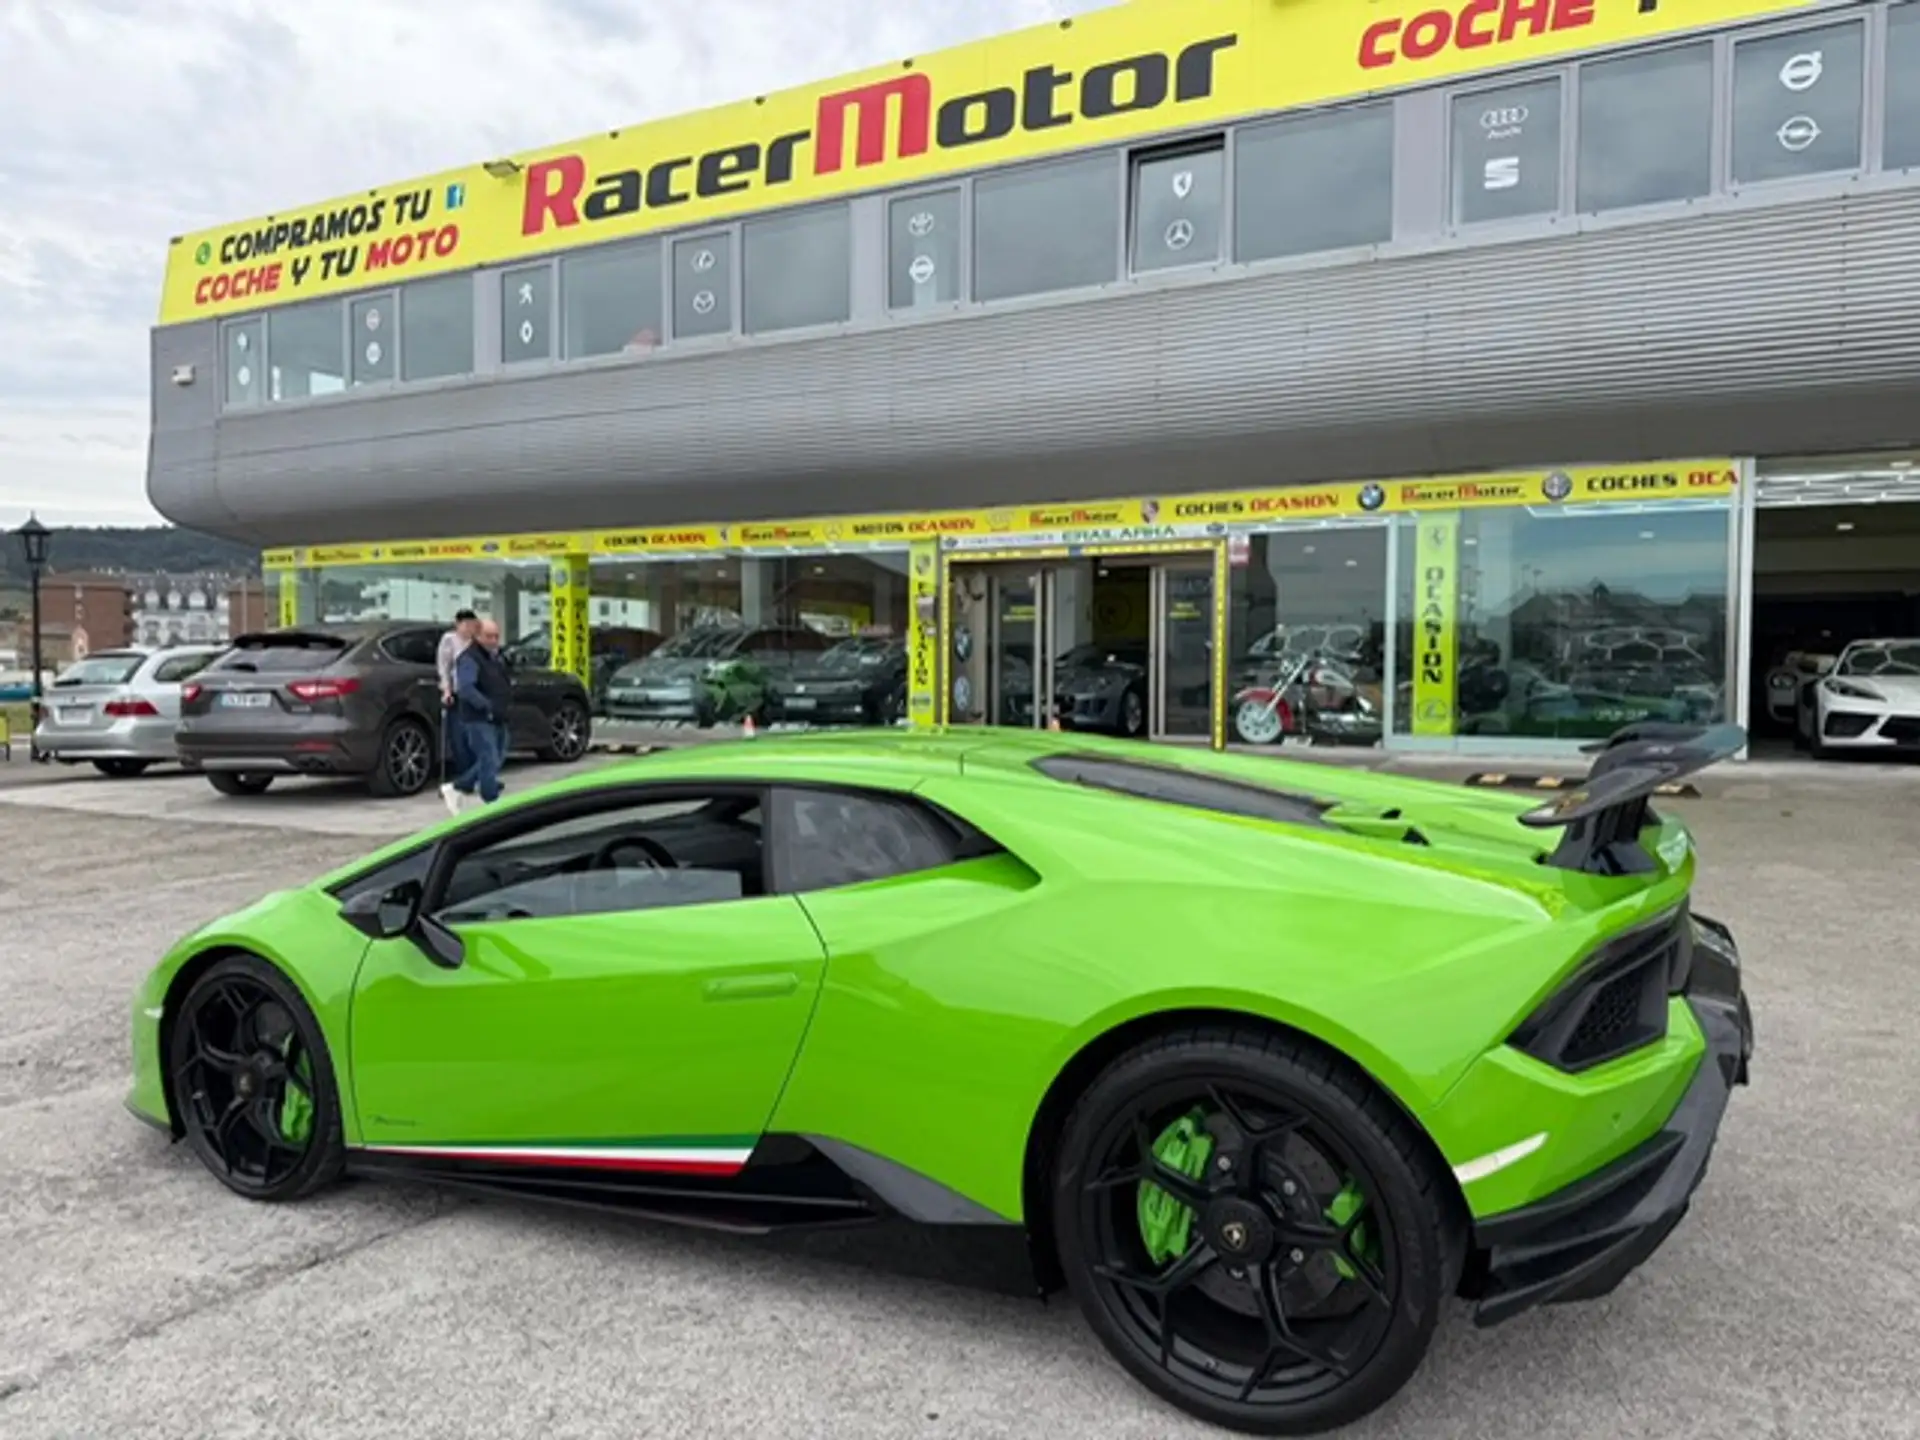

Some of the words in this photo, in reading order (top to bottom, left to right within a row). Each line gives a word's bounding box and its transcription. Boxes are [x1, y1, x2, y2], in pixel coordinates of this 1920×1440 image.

[1358, 0, 1595, 69] COCHE
[521, 34, 1238, 236] RacerMotor
[220, 197, 384, 264] COMPRAMOS
[394, 189, 432, 225] TU
[195, 264, 282, 304] COCHE
[291, 256, 312, 285] Y
[321, 246, 358, 280] TU
[365, 225, 459, 271] MOTO
[1401, 483, 1522, 502] RacerMotor
[1587, 474, 1678, 492] COCHES
[1688, 468, 1739, 486] OCA
[908, 516, 976, 532] OCASION
[1175, 501, 1244, 517] COCHES
[1250, 493, 1339, 512] OCASION
[651, 532, 706, 545] OCASION
[1423, 566, 1445, 685] OCASION
